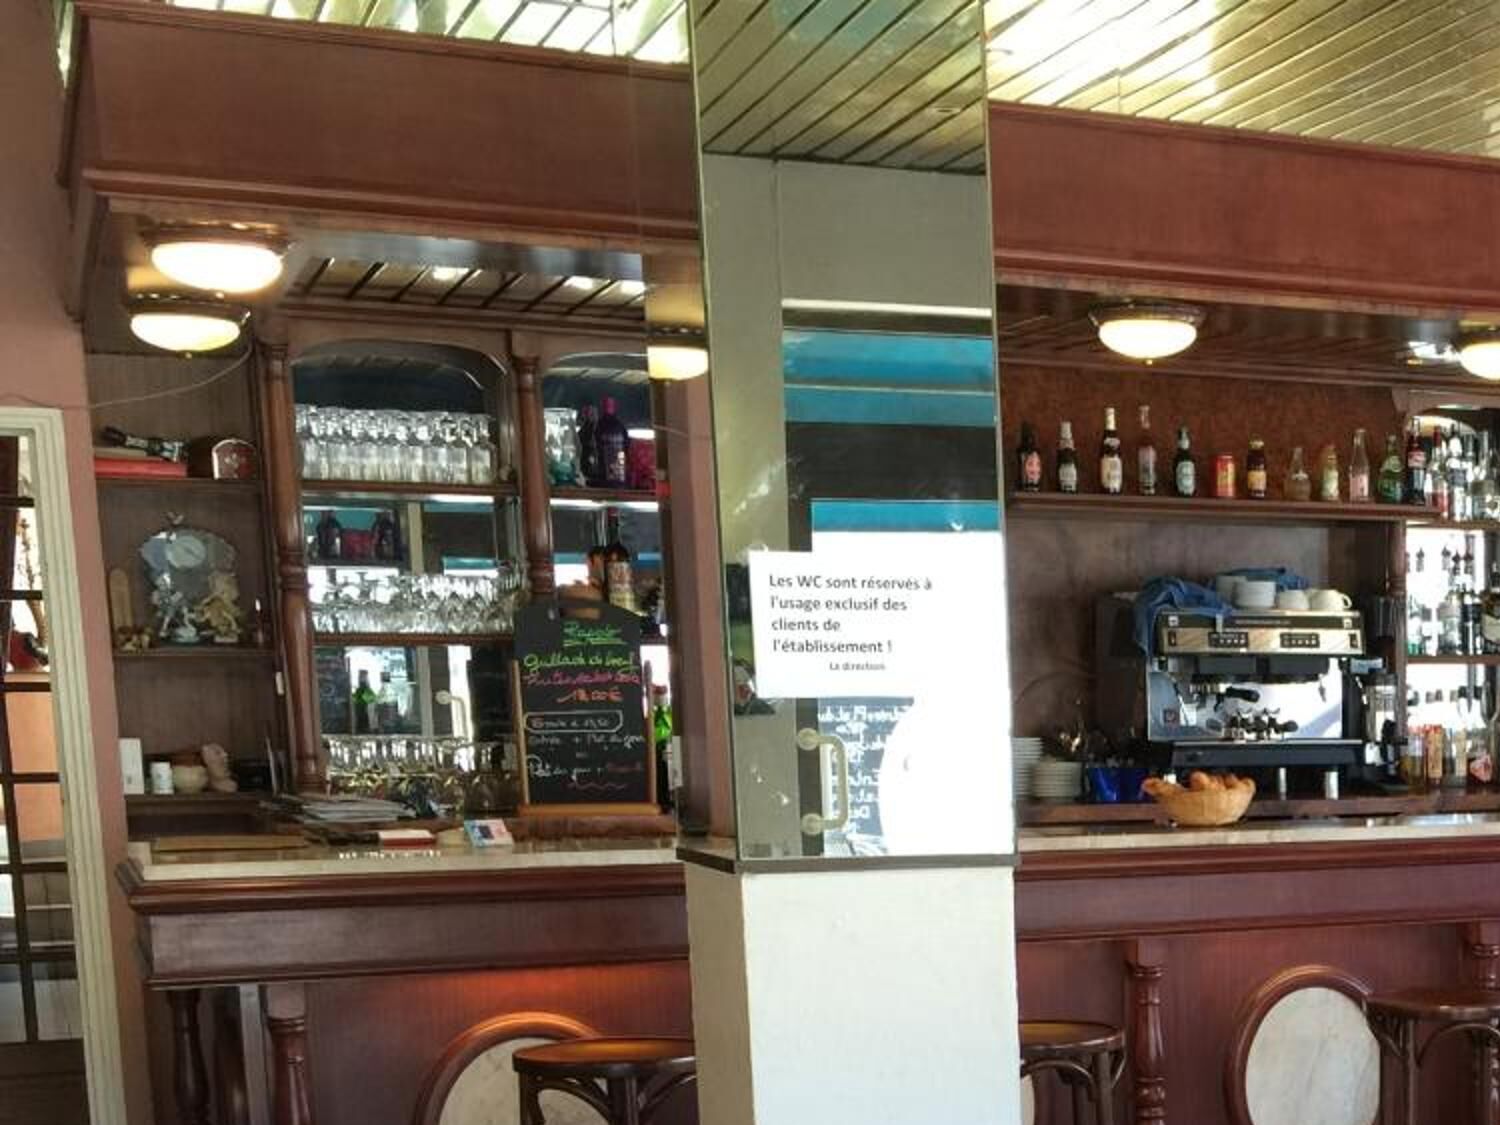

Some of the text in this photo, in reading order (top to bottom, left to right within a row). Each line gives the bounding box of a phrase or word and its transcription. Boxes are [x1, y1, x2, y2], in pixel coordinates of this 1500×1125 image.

[769, 574, 932, 590] Les WC sont réservés à
[770, 595, 908, 612] l'usage exclusif des
[771, 617, 841, 632] clients de
[773, 639, 892, 653] l'établissement !
